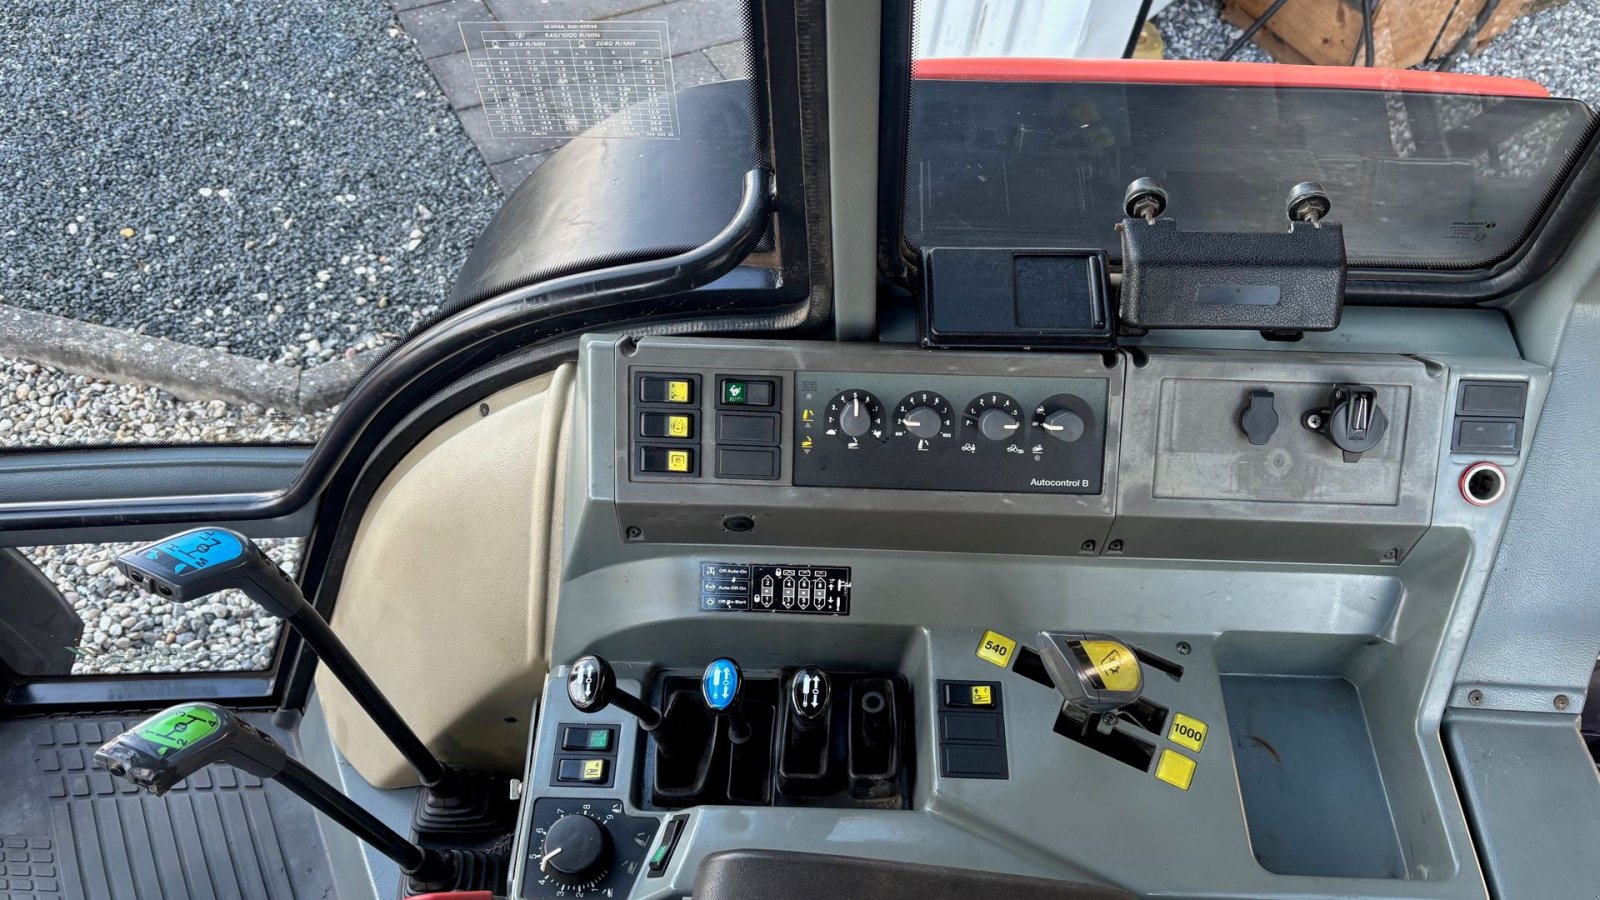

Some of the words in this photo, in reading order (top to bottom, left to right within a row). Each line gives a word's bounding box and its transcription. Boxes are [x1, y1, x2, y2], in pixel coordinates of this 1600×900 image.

[1030, 478, 1080, 487] Autocontrol
[196, 557, 208, 568] M
[985, 640, 1007, 656] 540
[1174, 722, 1202, 742] 1000
